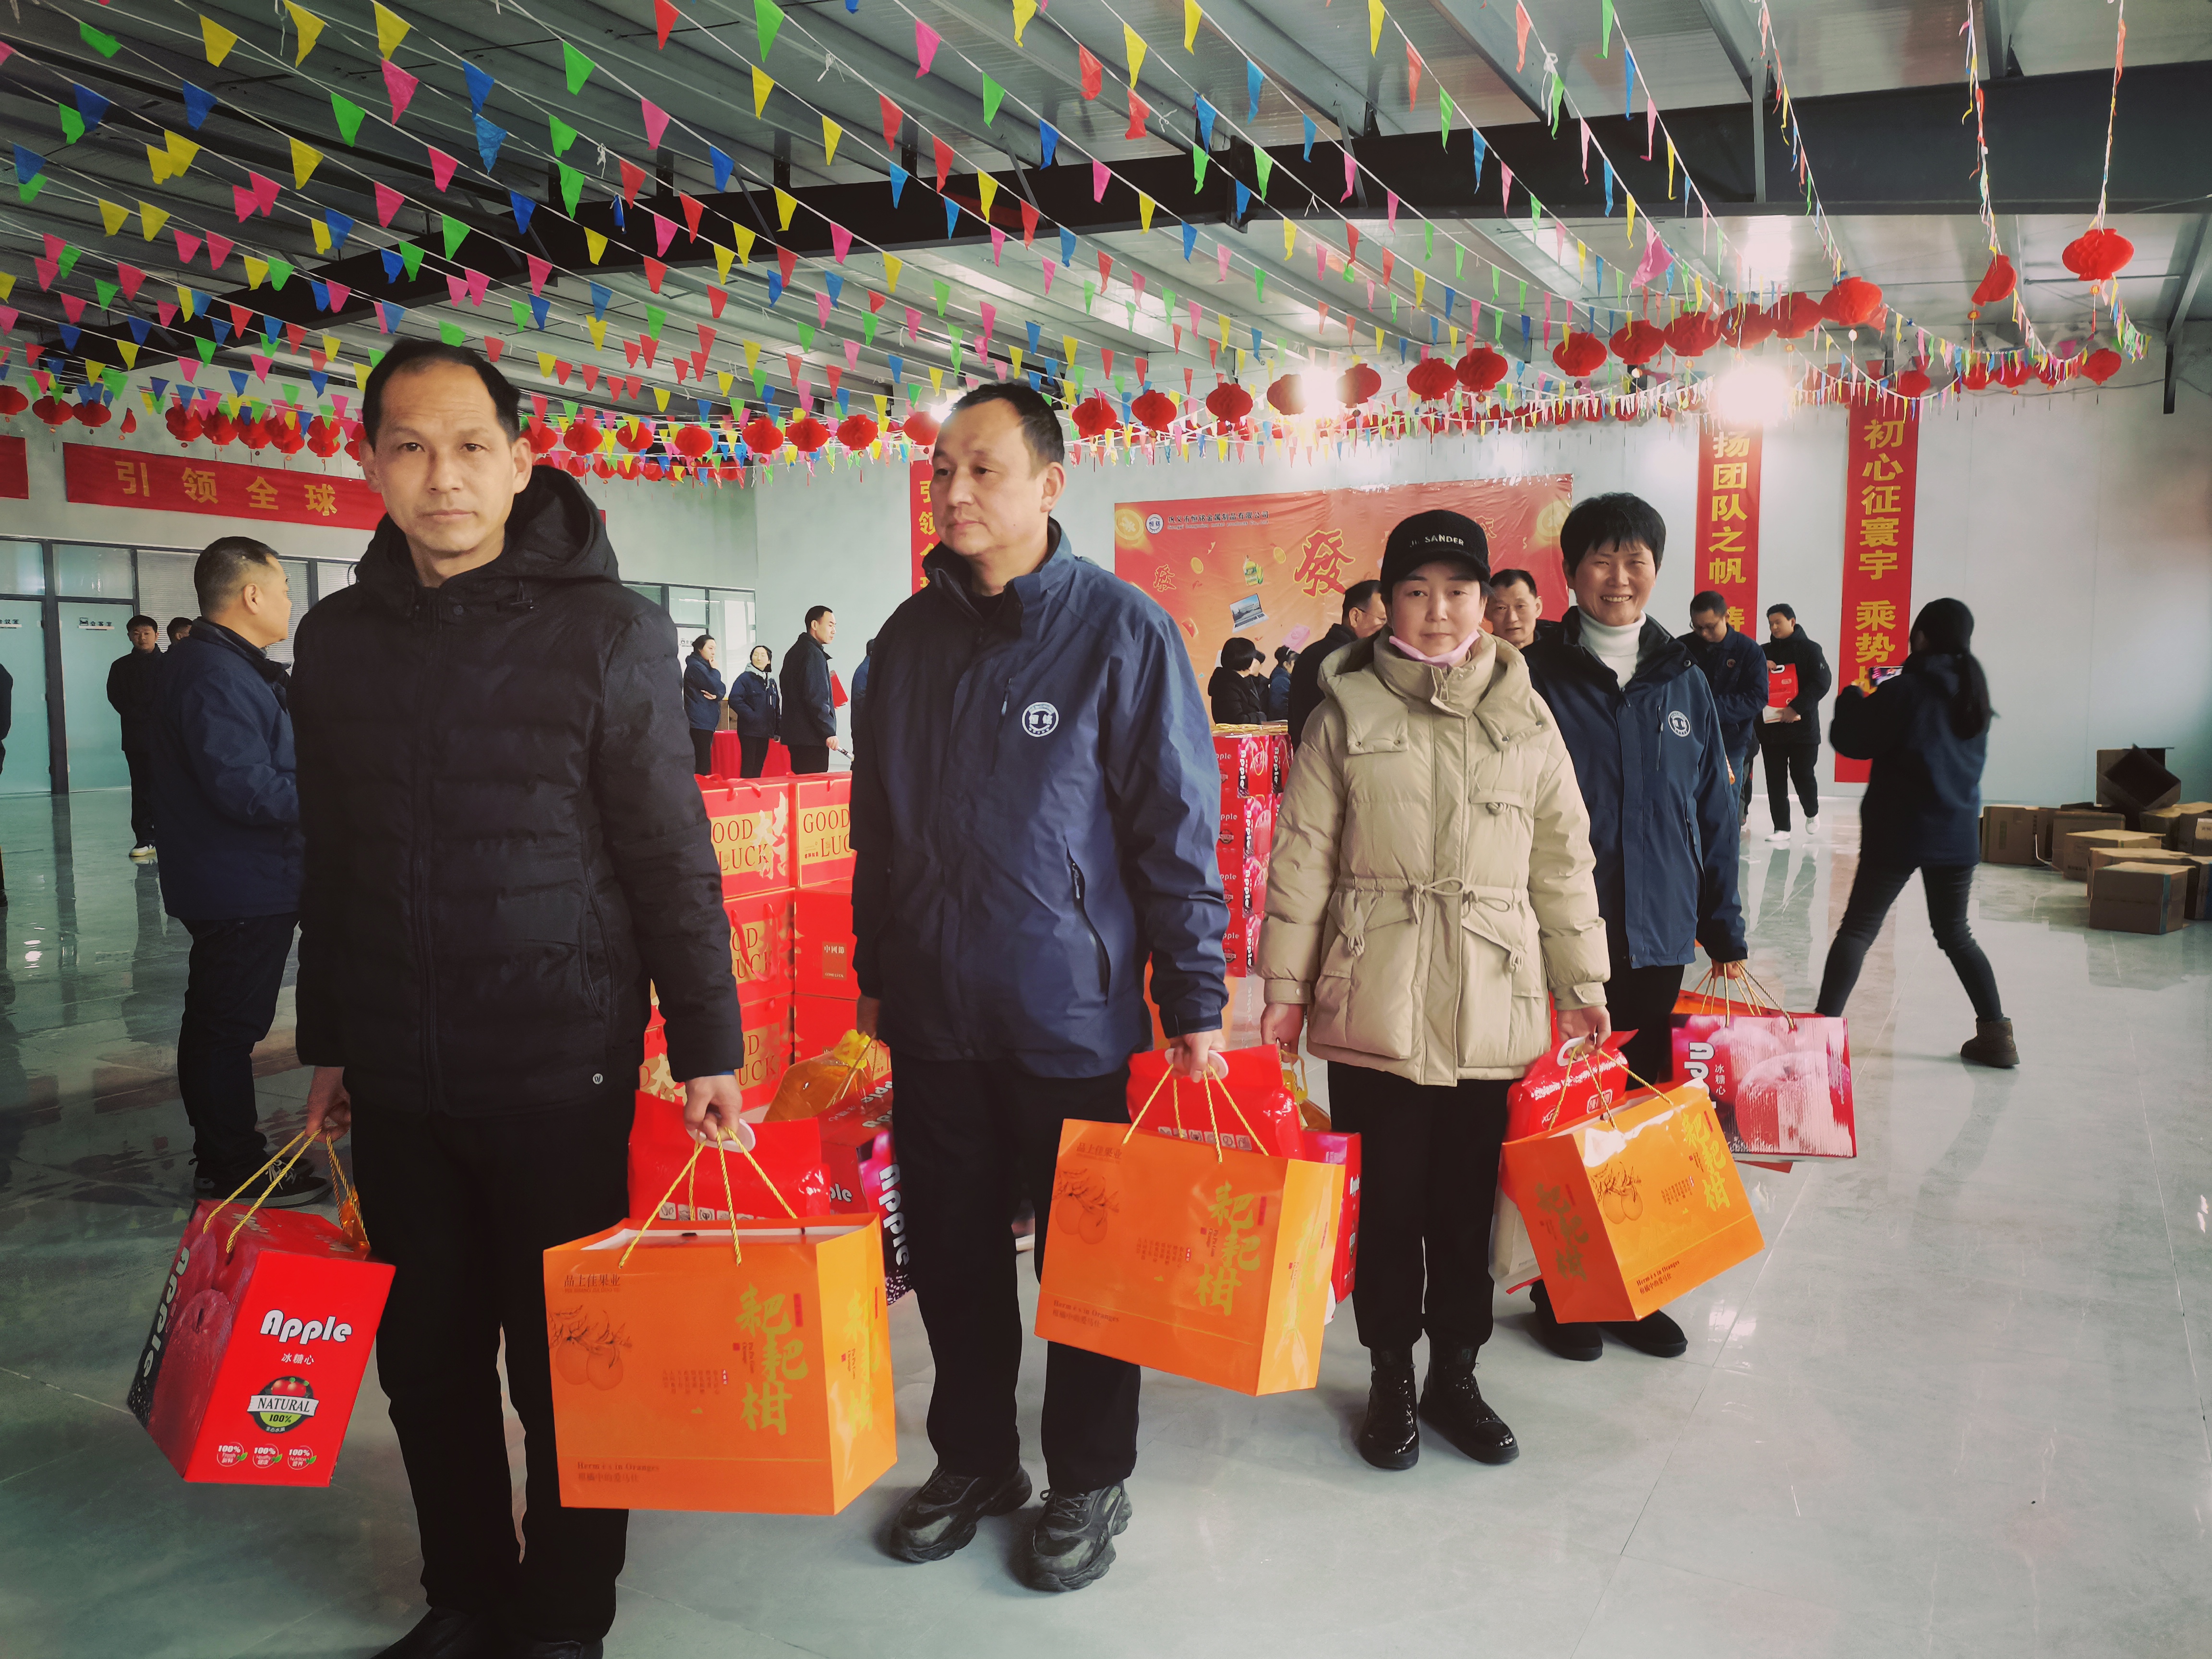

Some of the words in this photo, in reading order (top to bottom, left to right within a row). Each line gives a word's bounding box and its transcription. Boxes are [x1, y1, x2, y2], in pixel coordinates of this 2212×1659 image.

[115, 460, 337, 516] 引领全球
[1859, 420, 1904, 580] 初心征寰宇
[1708, 430, 1750, 584] 扬团队之帆
[1425, 534, 1464, 546] SANDER
[804, 809, 850, 833] GOOD
[1220, 813, 1238, 821] pple
[712, 819, 753, 843] OOD
[718, 843, 769, 871] LUCK
[821, 833, 850, 857] LUC
[830, 1183, 853, 1203] ple
[878, 1163, 910, 1266] Apple
[144, 1247, 190, 1378] Apple
[260, 1309, 353, 1345] Apple
[281, 1353, 314, 1365] 冰糖心
[258, 1397, 310, 1412] NATURAL
[269, 1414, 291, 1423] 100%
[218, 1445, 241, 1453] 100%
